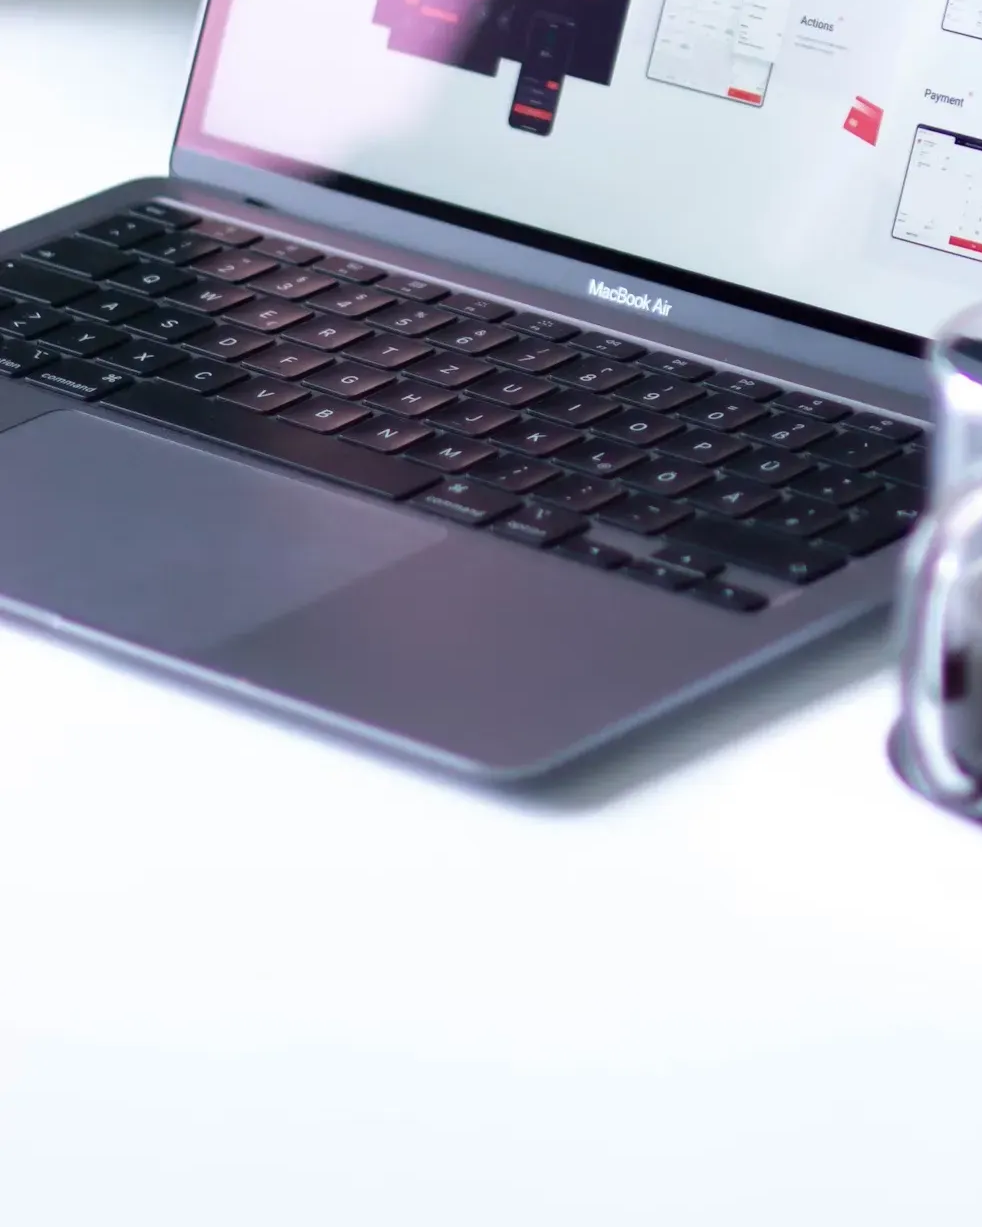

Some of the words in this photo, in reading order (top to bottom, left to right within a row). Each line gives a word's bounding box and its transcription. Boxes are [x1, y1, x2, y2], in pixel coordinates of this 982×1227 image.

[800, 15, 835, 32] Actions
[924, 88, 965, 107] Payment
[200, 290, 222, 302] W
[588, 278, 652, 311] MacBook
[652, 298, 673, 317] Air
[101, 302, 119, 311] A
[336, 299, 352, 309] 4
[260, 311, 278, 320] E
[161, 319, 179, 329] S
[395, 317, 413, 327] 5
[78, 333, 96, 342] Y
[319, 328, 337, 338] R
[219, 337, 238, 347] D
[456, 335, 474, 345] 6
[382, 347, 399, 355] T
[133, 352, 154, 362] X
[279, 356, 298, 366] F
[518, 354, 536, 363] 7
[440, 364, 460, 374] Z
[194, 371, 213, 382] C
[340, 375, 360, 385] G
[579, 373, 598, 382] 8
[41, 373, 97, 393] command
[503, 384, 523, 394] U
[256, 389, 276, 400] V
[401, 393, 422, 404] H
[643, 391, 661, 401] 9
[314, 409, 335, 420] B
[465, 414, 484, 423] J
[629, 422, 648, 432] O
[377, 428, 399, 439] N
[526, 432, 547, 442] K
[693, 441, 713, 450] P
[438, 447, 462, 459] M
[592, 452, 606, 461] L
